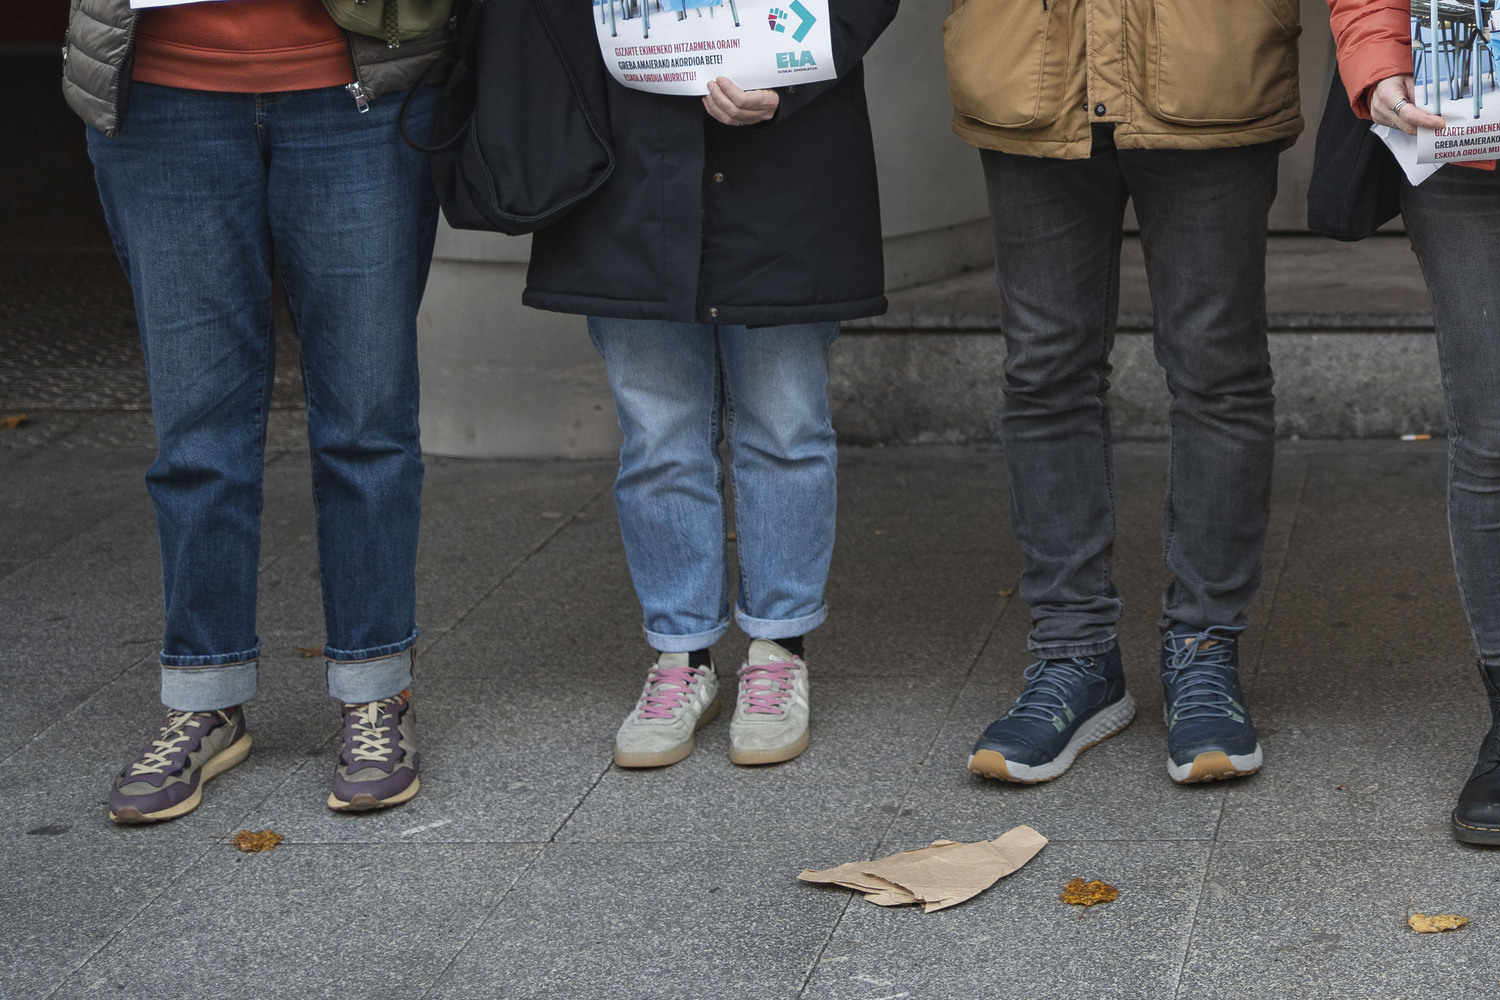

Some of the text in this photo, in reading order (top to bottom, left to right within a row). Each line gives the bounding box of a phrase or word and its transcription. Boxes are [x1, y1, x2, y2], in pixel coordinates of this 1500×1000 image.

[615, 39, 740, 56] GIZARTE EKIMENEKO HITZARMENA ORAIN!
[618, 55, 723, 69] GREBA AMAIERAKO AKORDIOA BETE!
[776, 51, 816, 68] ELA
[663, 71, 696, 82] MURRIZTU!
[1435, 127, 1464, 136] GIZARTE
[1435, 140, 1458, 149] GREBA
[1459, 135, 1500, 147] AMAIERAKO
[1435, 151, 1461, 159] ESKOLA
[1463, 148, 1487, 156] ORDUA
